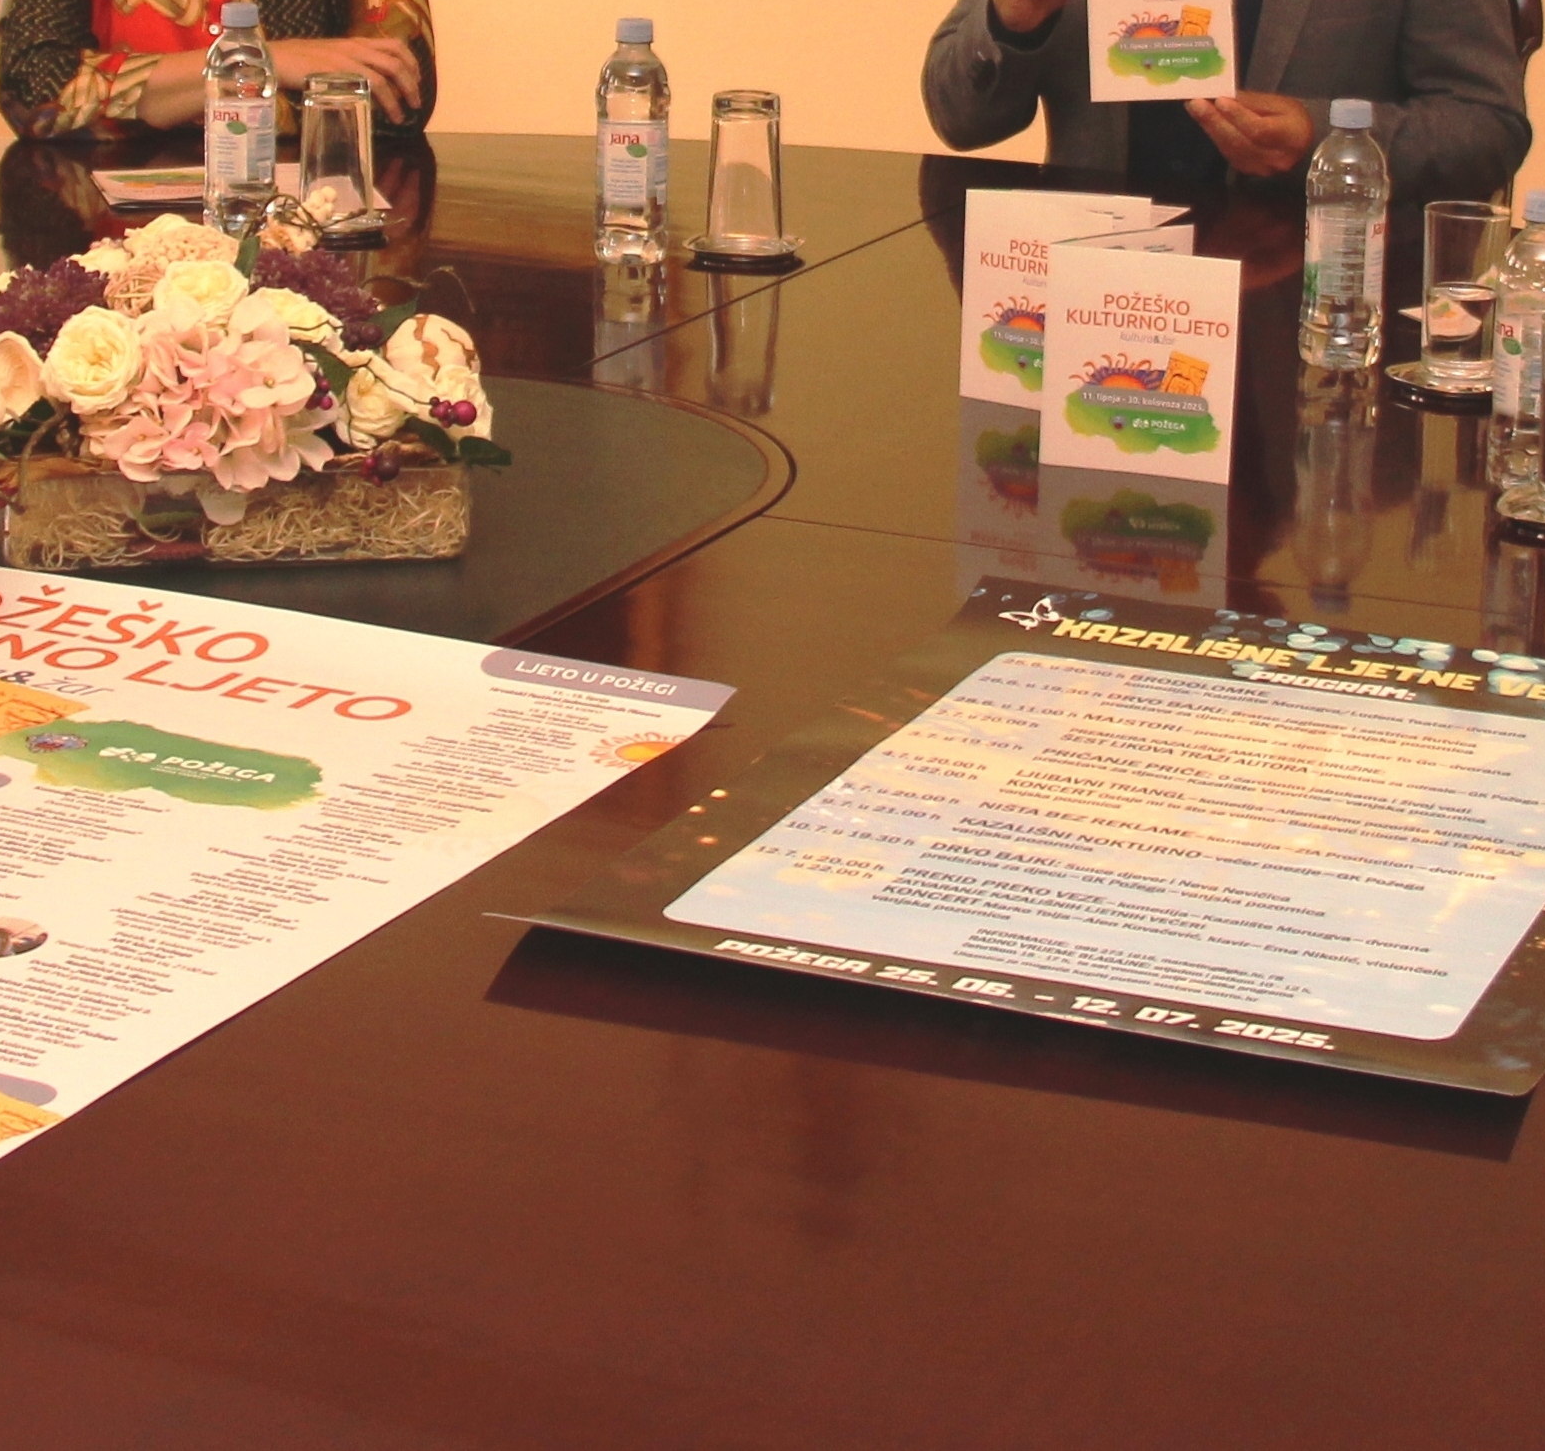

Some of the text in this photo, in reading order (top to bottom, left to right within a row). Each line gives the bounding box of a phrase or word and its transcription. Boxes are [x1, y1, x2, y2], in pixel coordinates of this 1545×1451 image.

[980, 251, 1048, 276] KULTURN
[1010, 239, 1048, 260] POŽE
[1104, 292, 1190, 316] POŽEŠKO
[1066, 308, 1230, 338] KULTURNO LJETO
[1050, 617, 1308, 666] KAZALIŠNE
[1305, 654, 1482, 690] LJETNE
[124, 661, 413, 722] LJETO
[512, 660, 579, 679] LJETO
[598, 674, 679, 695] POŽEGI
[1129, 674, 1270, 697] BRODOLOMKE
[1249, 669, 1417, 700] PROGRAM:
[1082, 713, 1183, 732] MAJSTORI
[1041, 747, 1138, 766] PRIČANJE
[1059, 733, 1309, 773] ŠEST LIKOVA TRAŽI AUTORA
[160, 755, 278, 783] POŽEGA
[1006, 778, 1096, 797] KONCERT
[1015, 769, 1186, 800] LJUBAVNI TRIANGL
[978, 800, 1192, 837] NIŠTA BEZ REKLAME
[959, 816, 1073, 839] KAZALIŠNI
[1075, 834, 1202, 859] NOKTURNO
[929, 841, 992, 857] DRVO
[994, 851, 1062, 867] BAJKI:
[881, 884, 982, 905] KONCERT
[900, 867, 978, 885] PREKID
[980, 879, 1051, 896] PREKO
[1055, 890, 1106, 904] VEZE
[714, 938, 872, 973] POŽEGA
[875, 965, 941, 985] 25.
[951, 977, 1018, 998] 06.
[1070, 995, 1123, 1016] 12.
[1134, 1006, 1202, 1028] 07.
[1214, 1019, 1336, 1050] 2025.
